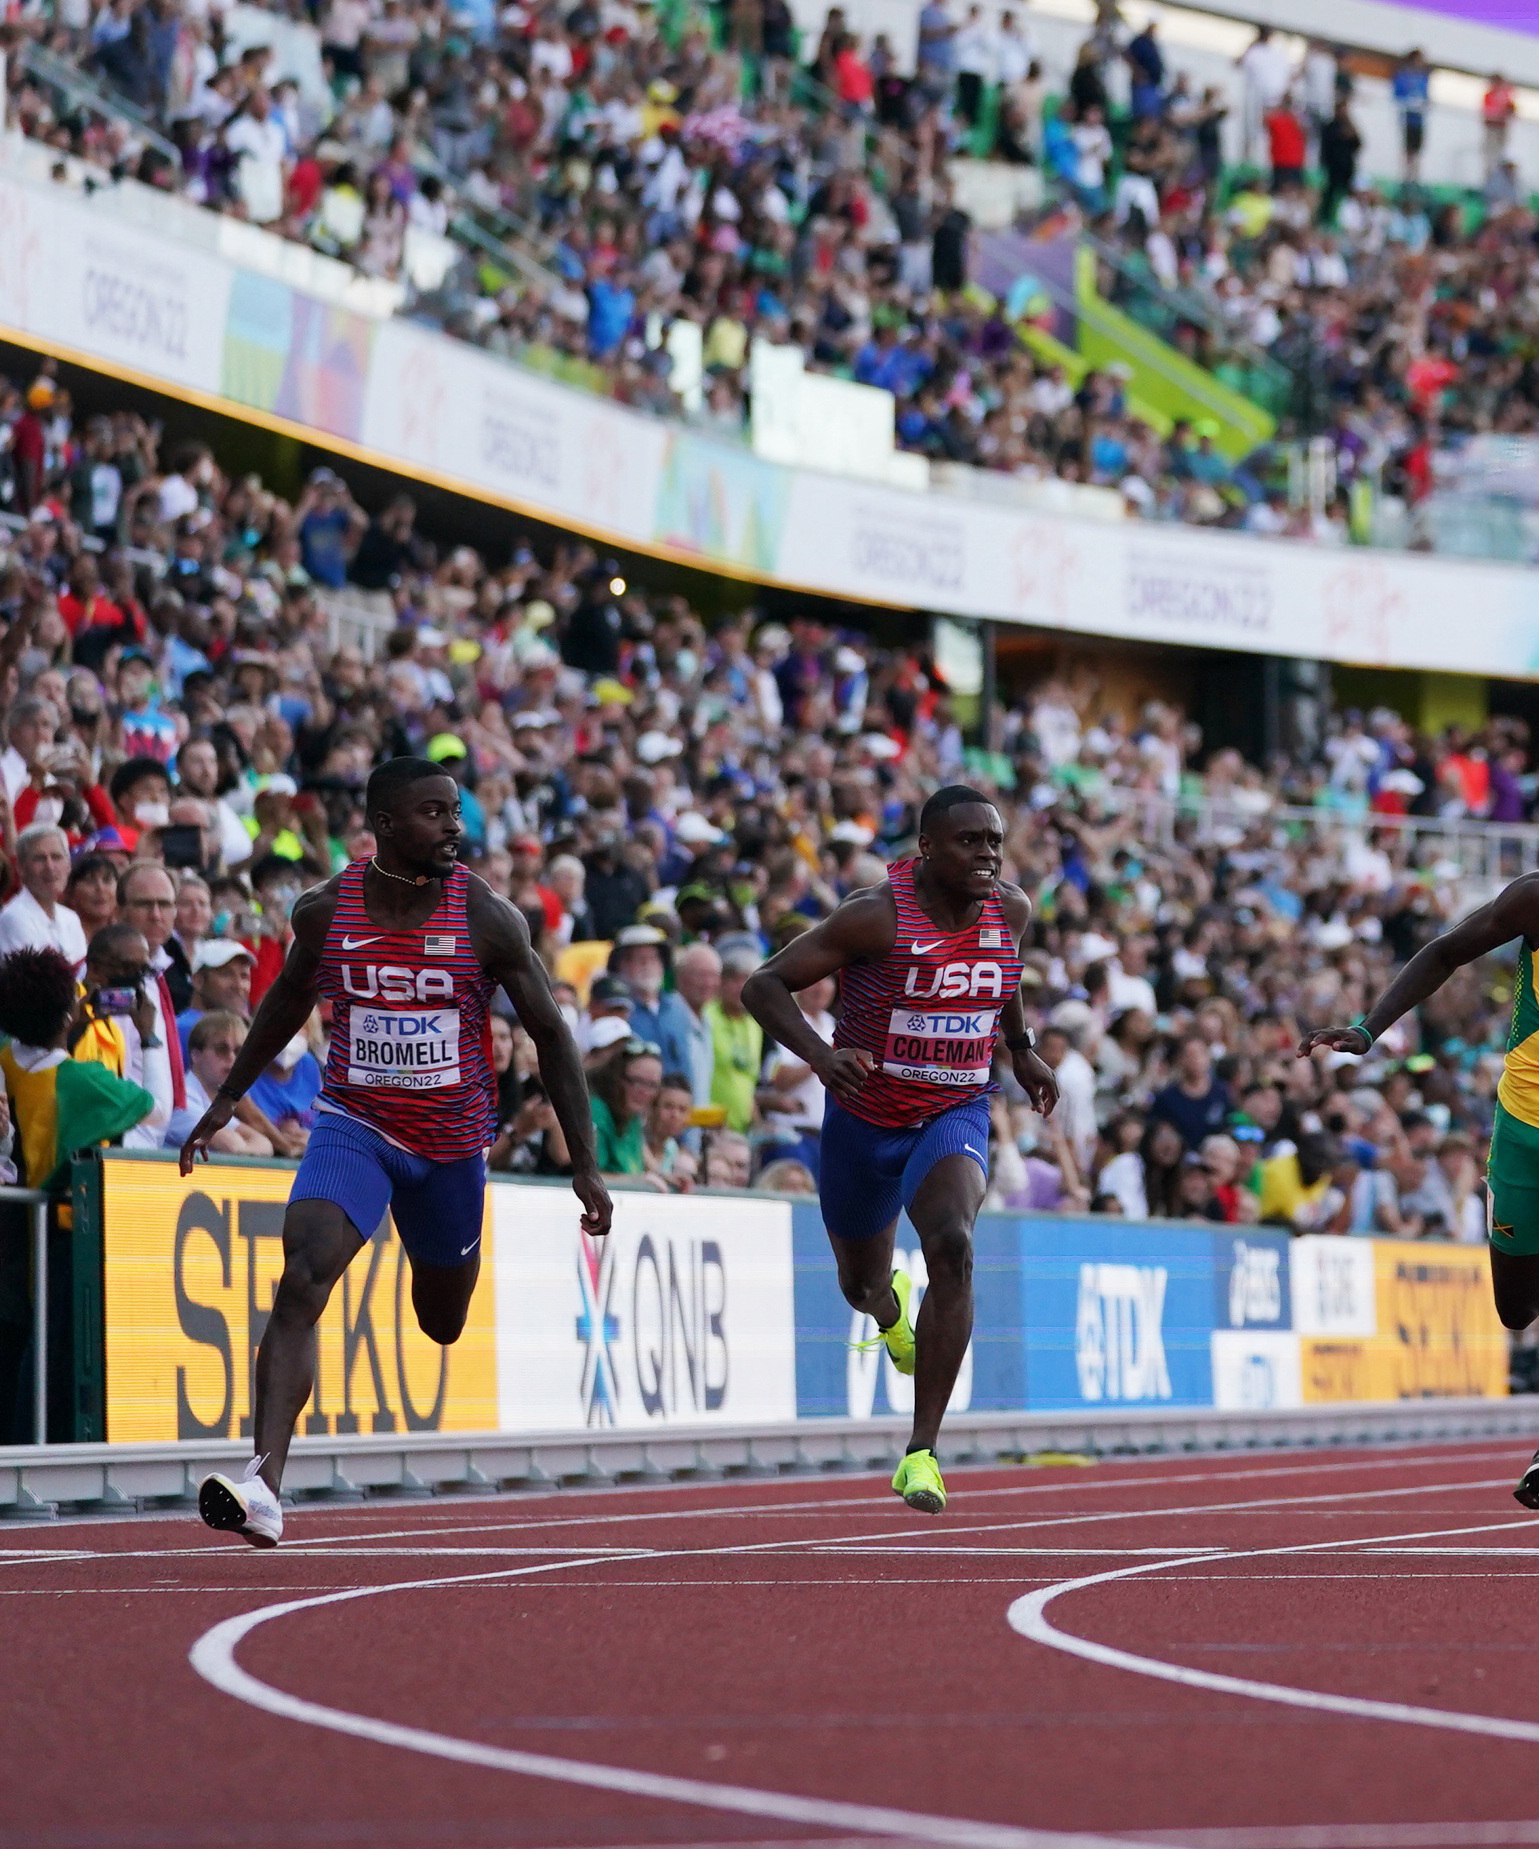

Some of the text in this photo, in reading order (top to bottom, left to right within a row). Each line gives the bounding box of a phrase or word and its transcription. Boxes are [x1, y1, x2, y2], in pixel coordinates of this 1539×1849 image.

[341, 964, 453, 1002] USA
[904, 961, 1002, 998] USA
[378, 1015, 442, 1035] TDK
[927, 1015, 982, 1033] TDK
[355, 1038, 453, 1066] BROMELL
[893, 1037, 985, 1063] COLEMAN
[365, 1073, 442, 1087] OREGON22
[901, 1068, 976, 1083] OREGON22
[634, 1234, 727, 1419] QNB
[1097, 1263, 1172, 1399] TDK
